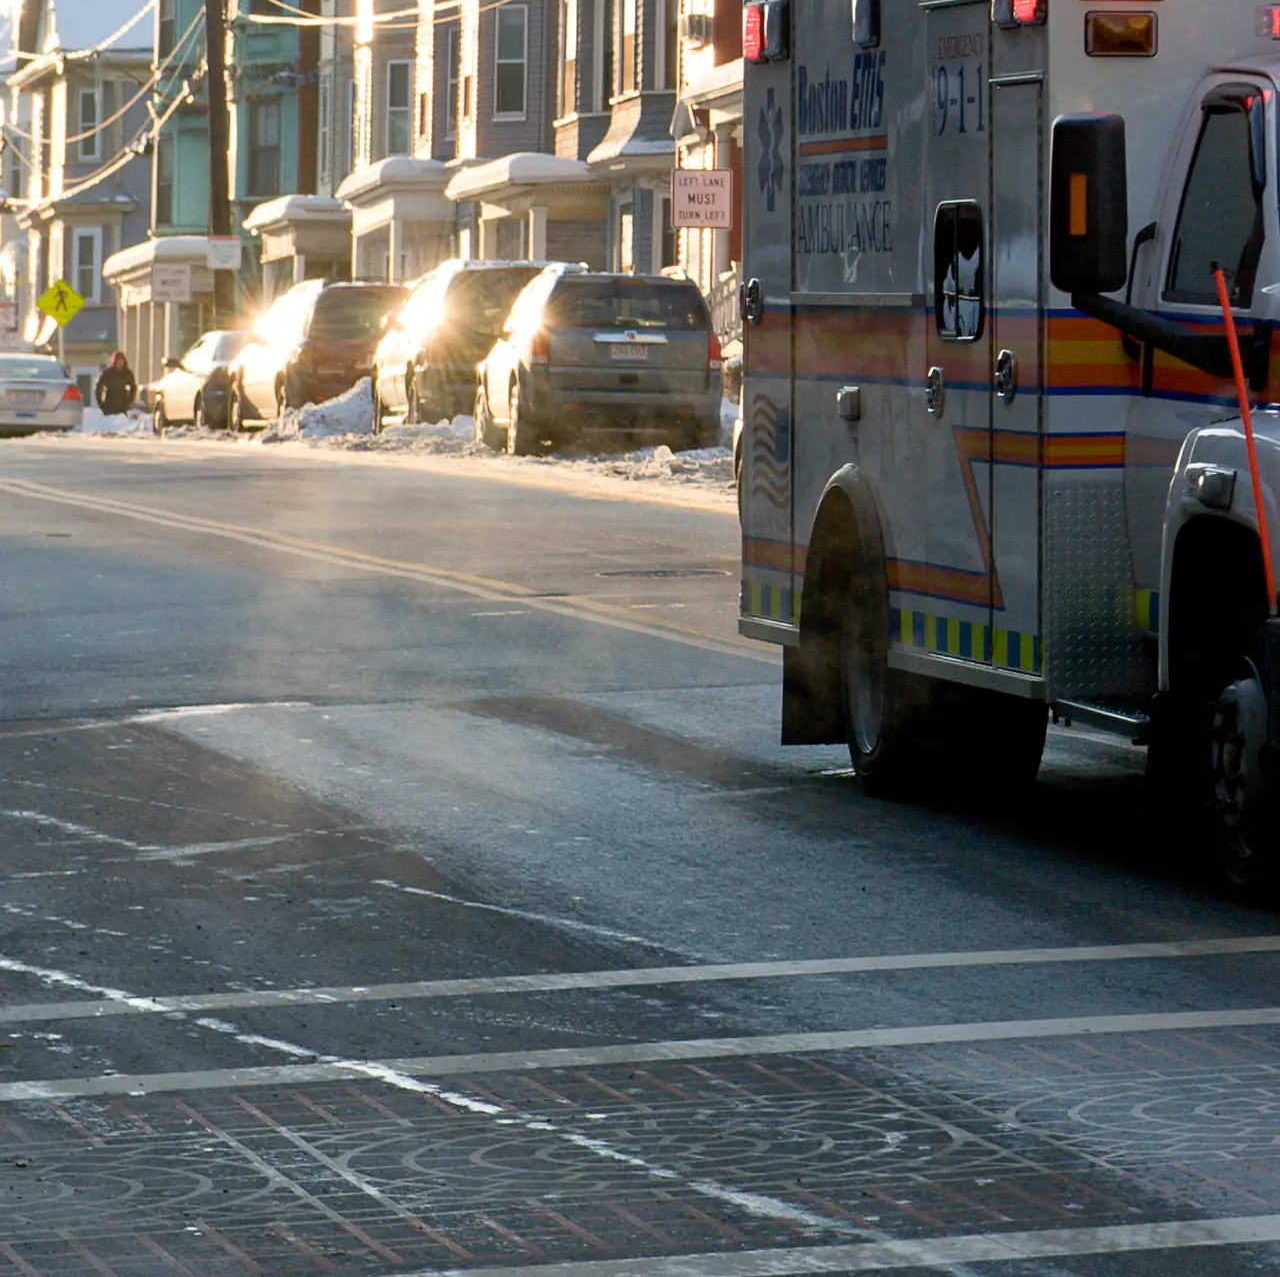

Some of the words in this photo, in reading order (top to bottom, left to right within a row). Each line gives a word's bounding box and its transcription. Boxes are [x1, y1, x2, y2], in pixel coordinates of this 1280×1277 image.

[798, 64, 848, 136] Boston
[850, 49, 886, 130] EMS
[937, 62, 985, 137] 9-1-1
[679, 177, 698, 186] LEFT
[703, 178, 725, 187] LANE
[679, 211, 700, 220] TURN
[705, 212, 725, 220] LEFT
[687, 193, 717, 205] MUST
[796, 200, 893, 254] AMBULANCE
